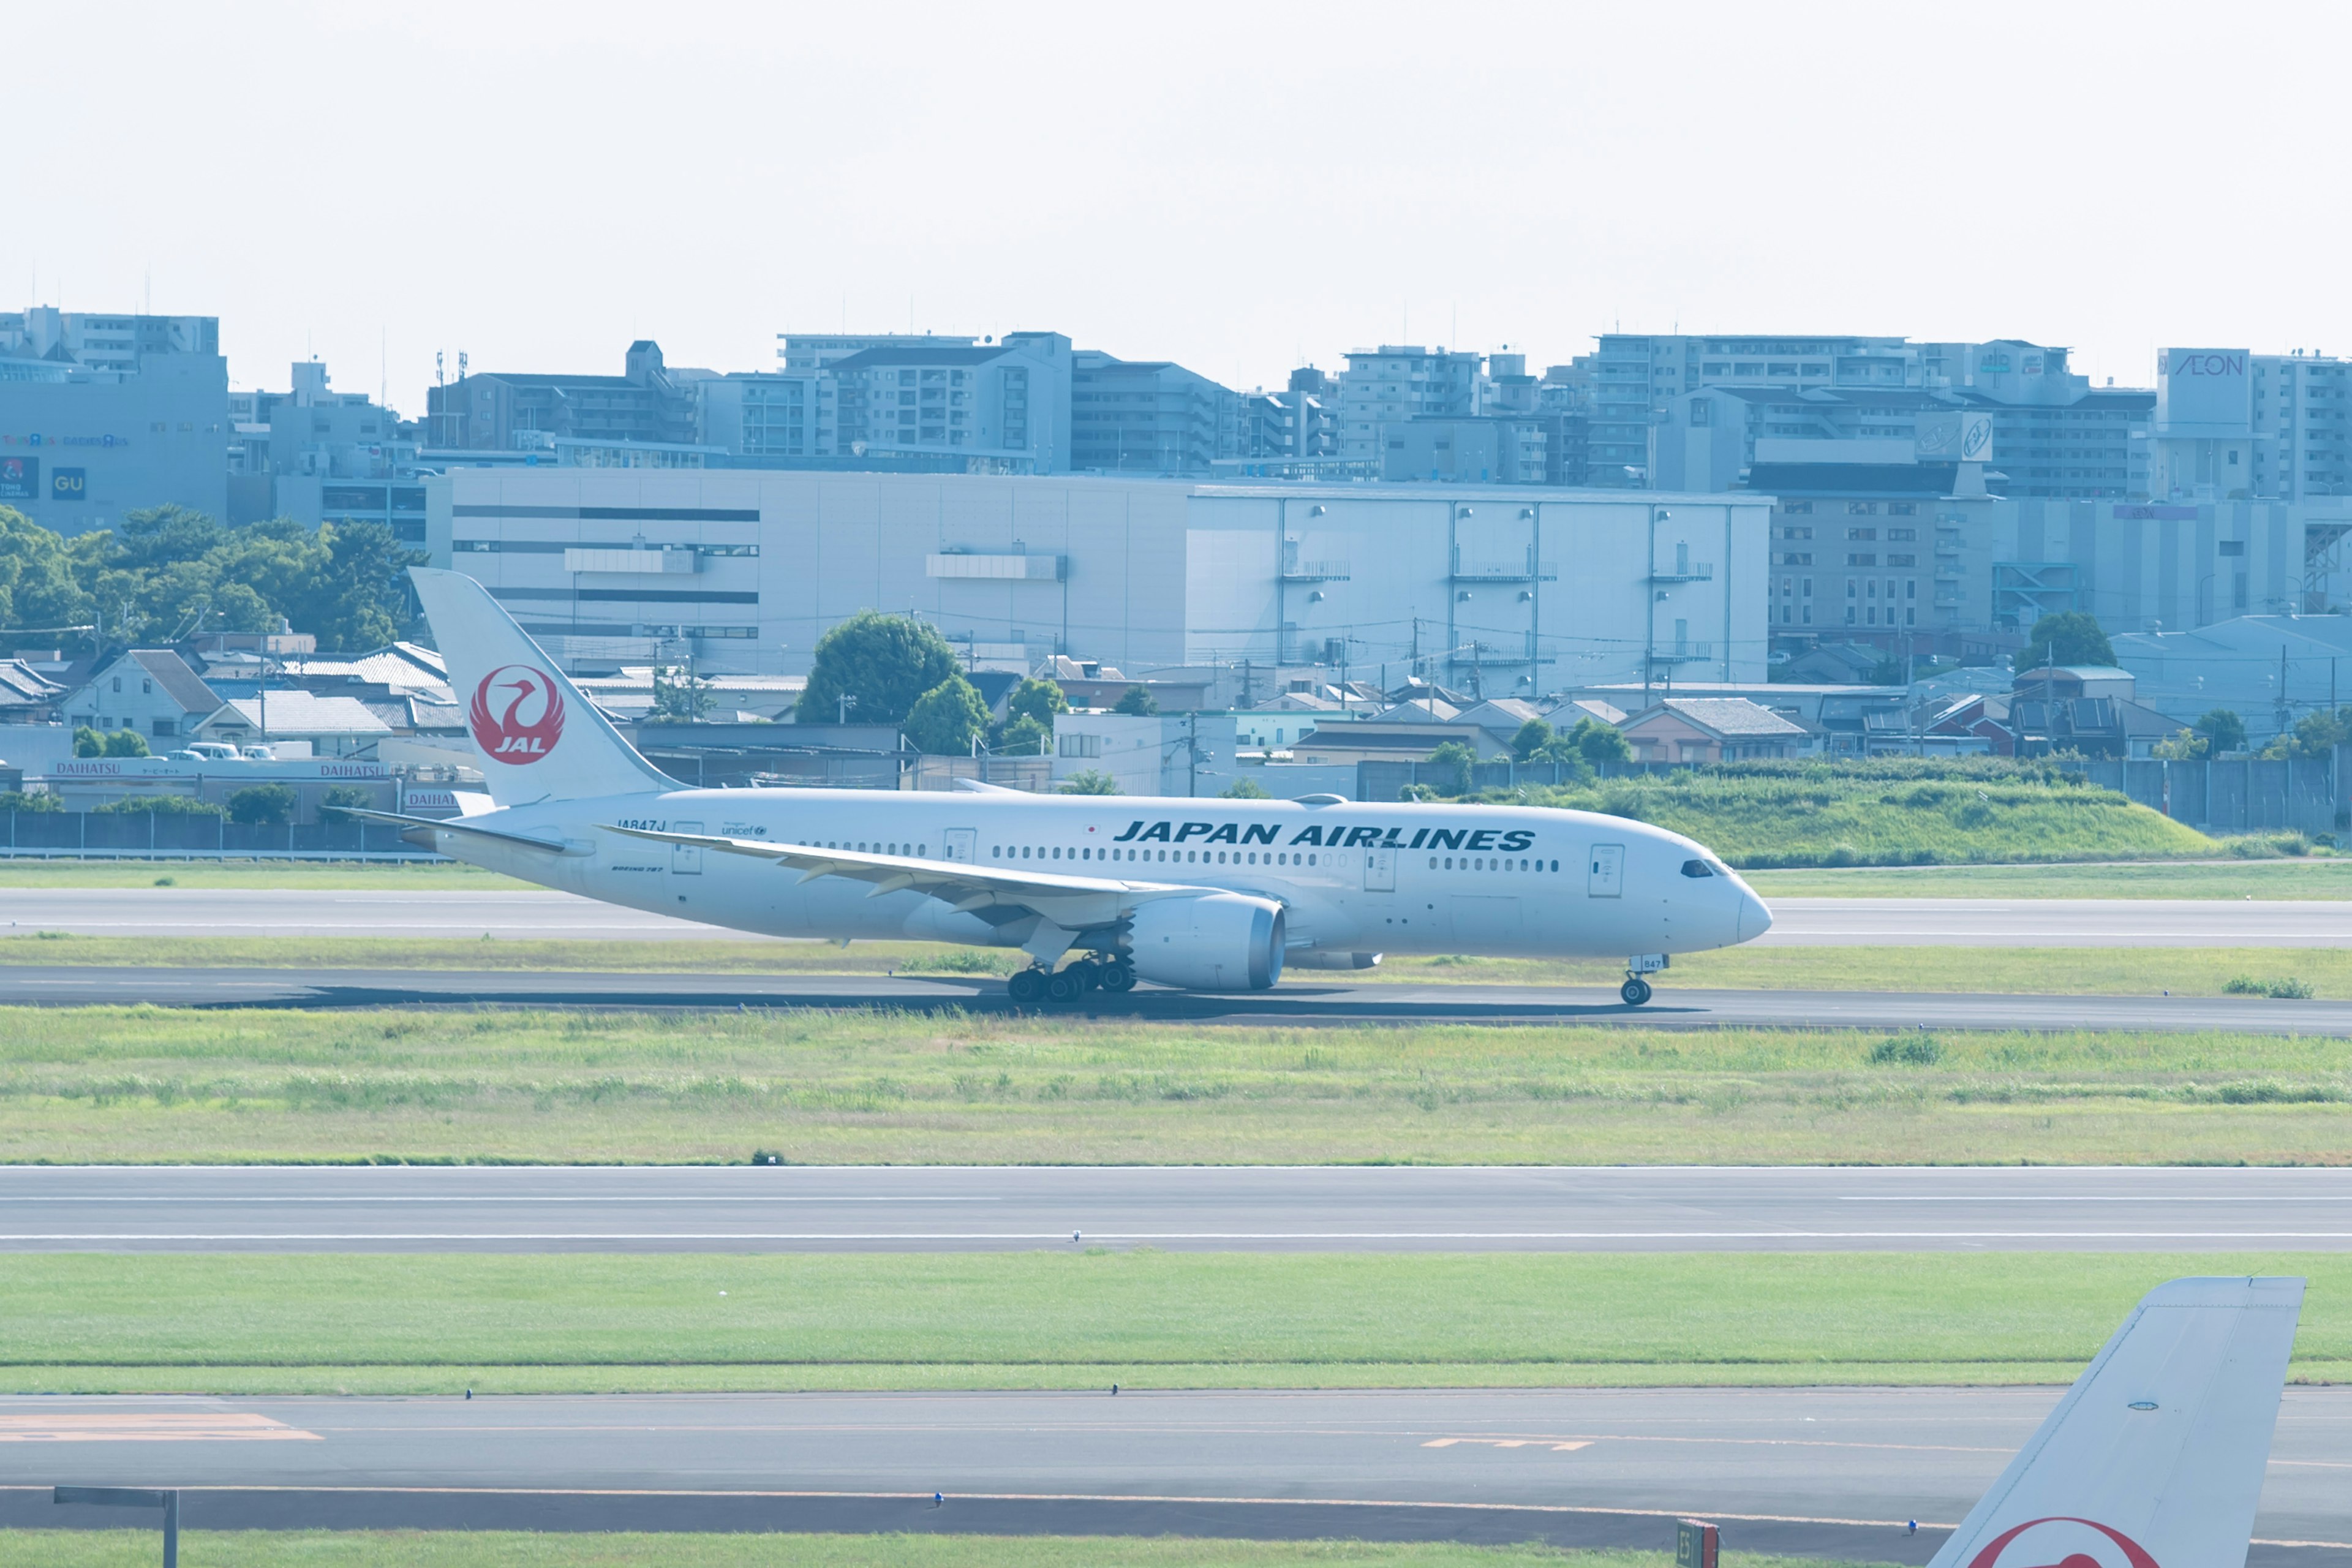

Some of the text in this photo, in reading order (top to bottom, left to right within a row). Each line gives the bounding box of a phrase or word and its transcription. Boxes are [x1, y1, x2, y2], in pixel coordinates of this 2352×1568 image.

[55, 476, 83, 491] GU
[494, 736, 546, 753] JAL
[56, 763, 120, 774] DAIHATSU
[321, 765, 384, 776] DAIHATSU
[722, 825, 753, 835] unicef
[1113, 821, 1536, 851] JAPAN AIRLINES
